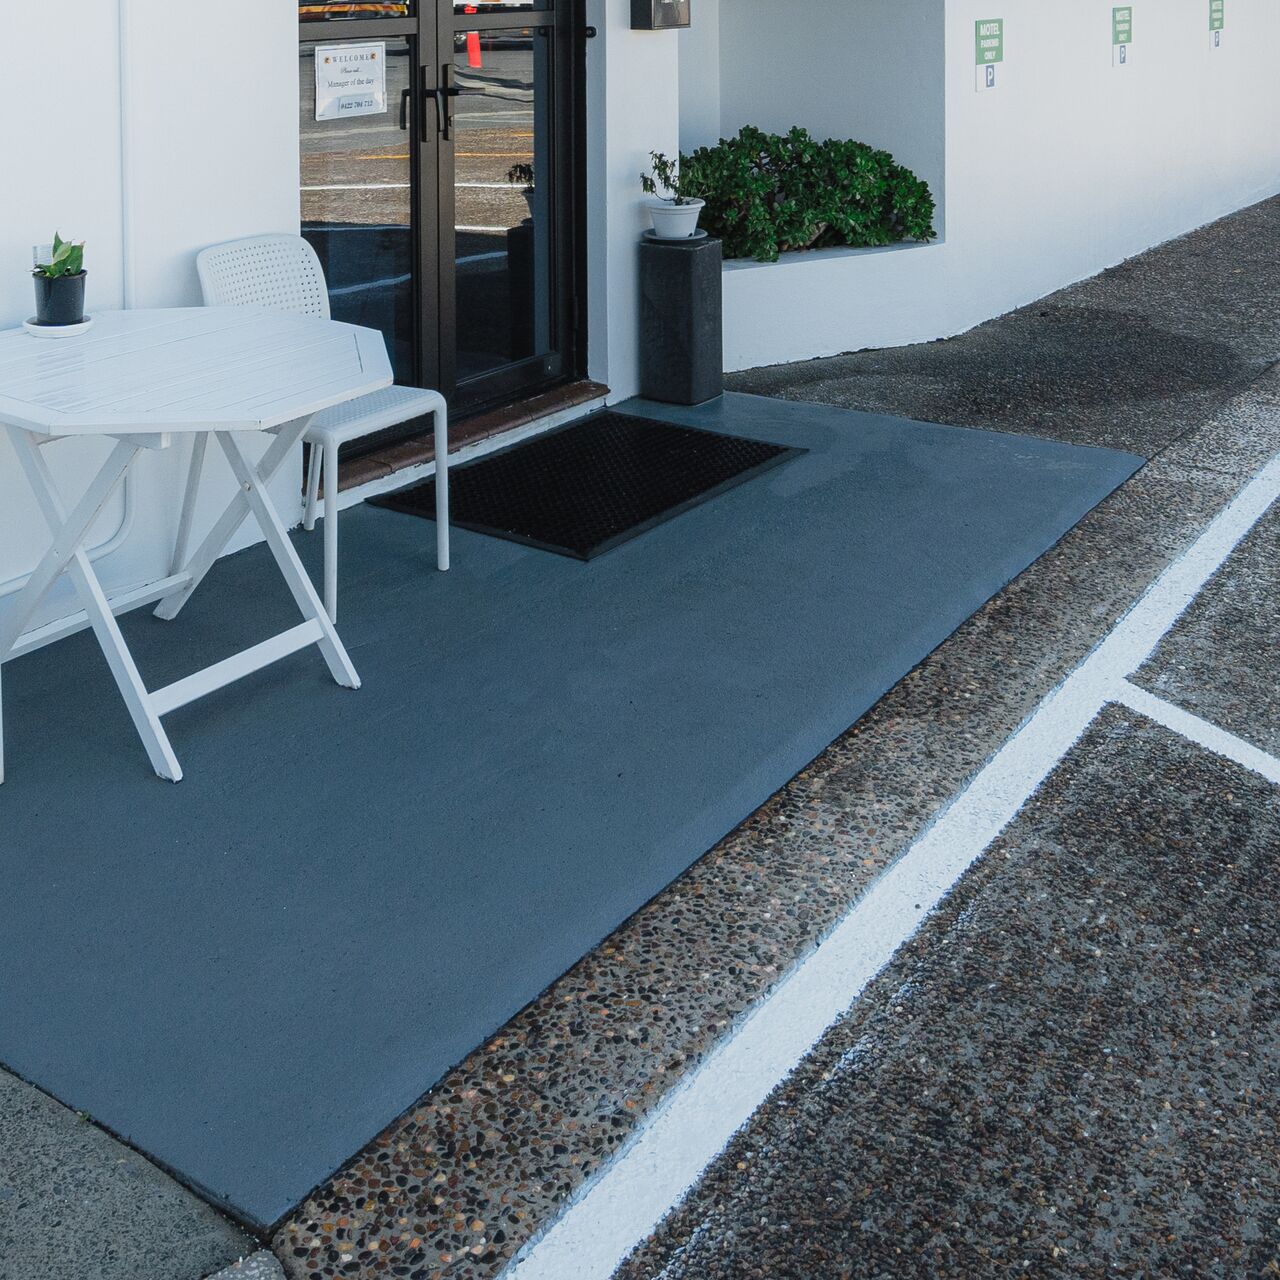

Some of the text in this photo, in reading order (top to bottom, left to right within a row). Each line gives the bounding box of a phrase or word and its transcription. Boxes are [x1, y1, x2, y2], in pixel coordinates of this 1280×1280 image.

[980, 23, 1000, 36] MOTEL
[332, 54, 370, 62] WELCOME
[984, 51, 996, 60] ONLY
[987, 67, 993, 86] P
[327, 79, 350, 88] Manager
